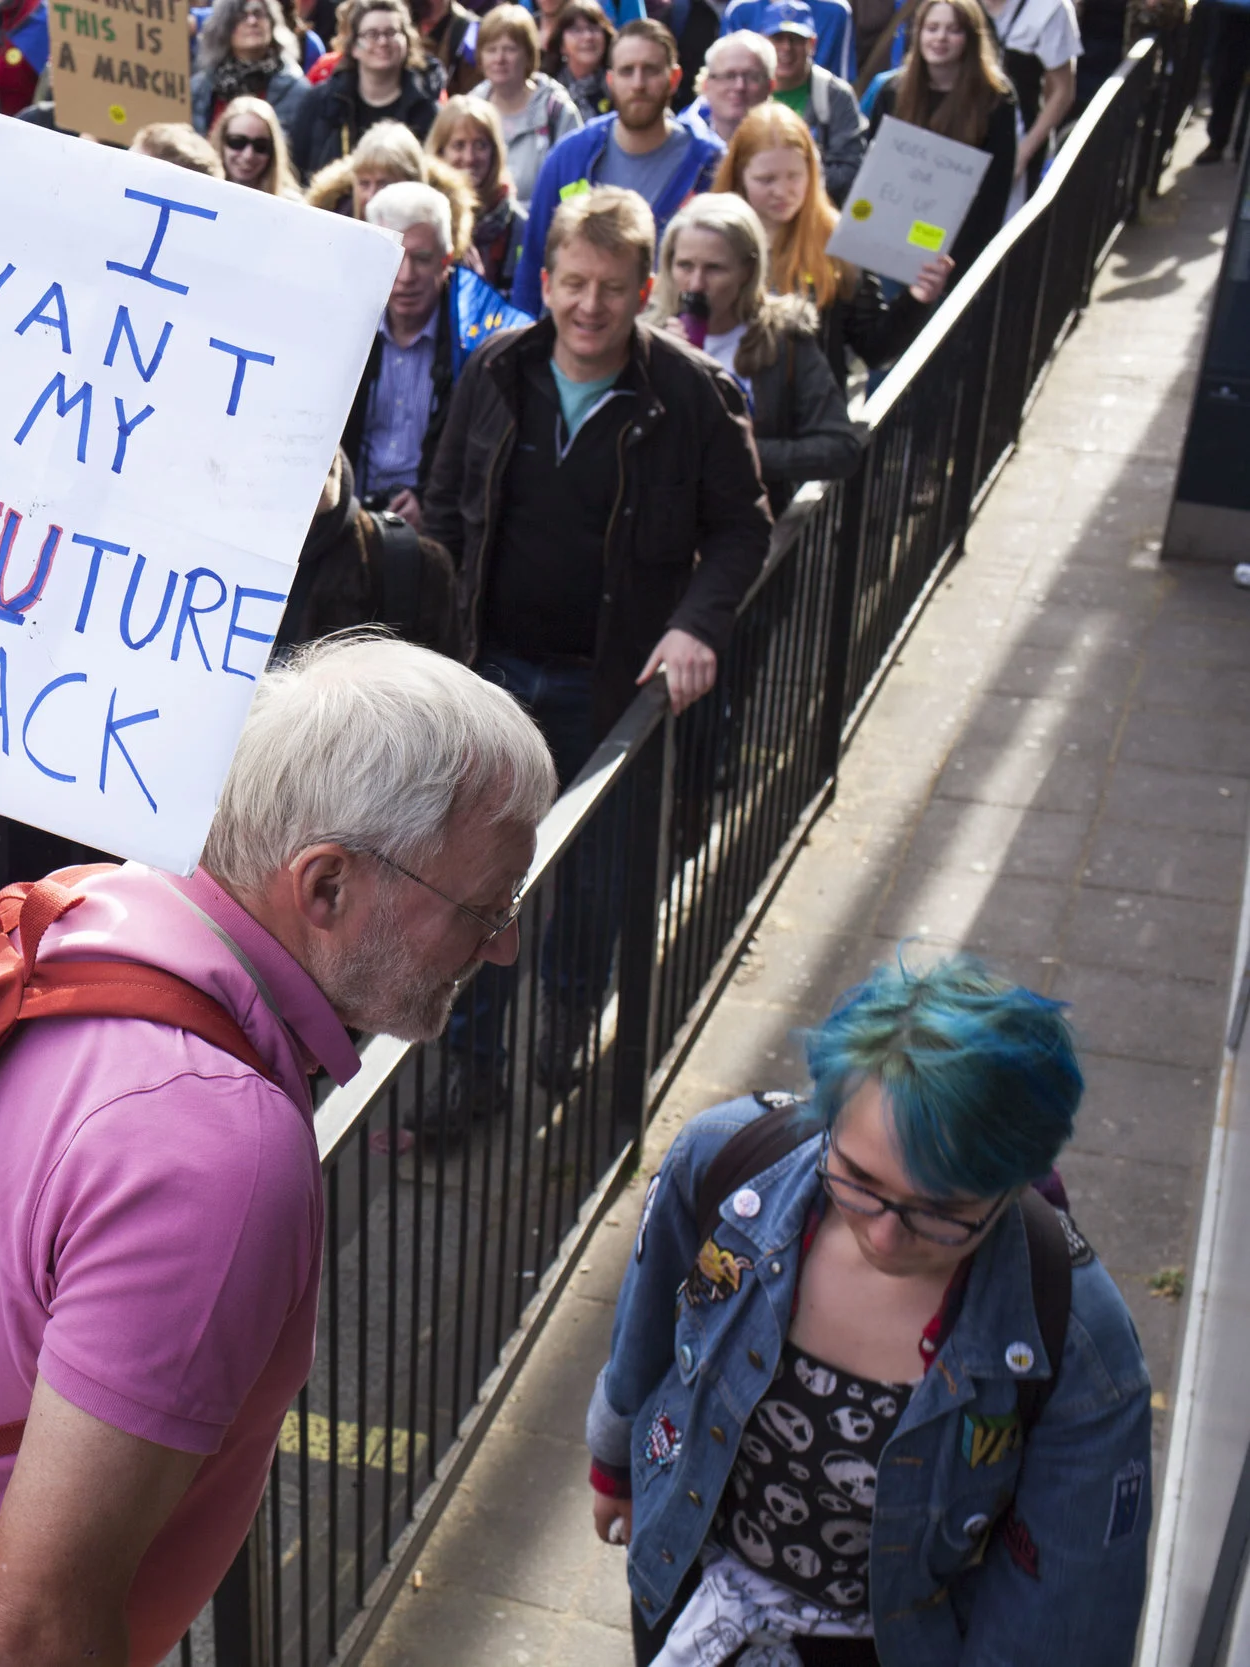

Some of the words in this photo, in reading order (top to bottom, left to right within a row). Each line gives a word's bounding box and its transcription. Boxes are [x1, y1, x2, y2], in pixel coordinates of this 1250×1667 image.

[53, 4, 116, 42] THIS
[136, 22, 162, 55] IS
[58, 41, 77, 73] A
[93, 53, 185, 105] MARCH!
[106, 189, 218, 295] I
[14, 372, 154, 473] MY
